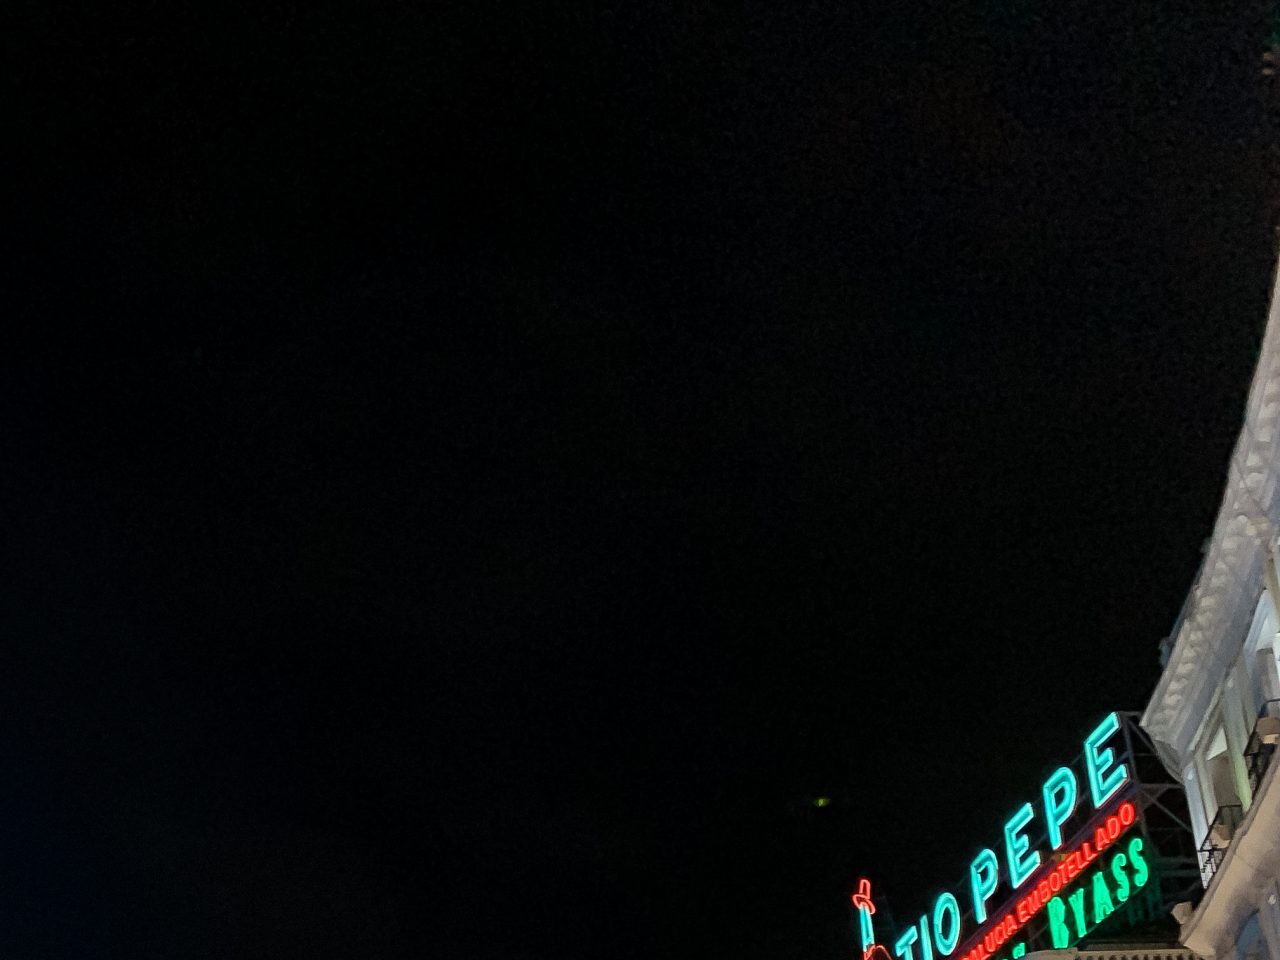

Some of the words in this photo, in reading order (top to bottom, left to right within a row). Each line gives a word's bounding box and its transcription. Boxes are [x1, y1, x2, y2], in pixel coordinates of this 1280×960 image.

[970, 711, 1130, 924] PEPE
[1016, 802, 1136, 923] EMBOTELLADO
[1047, 837, 1149, 949] BYASS
